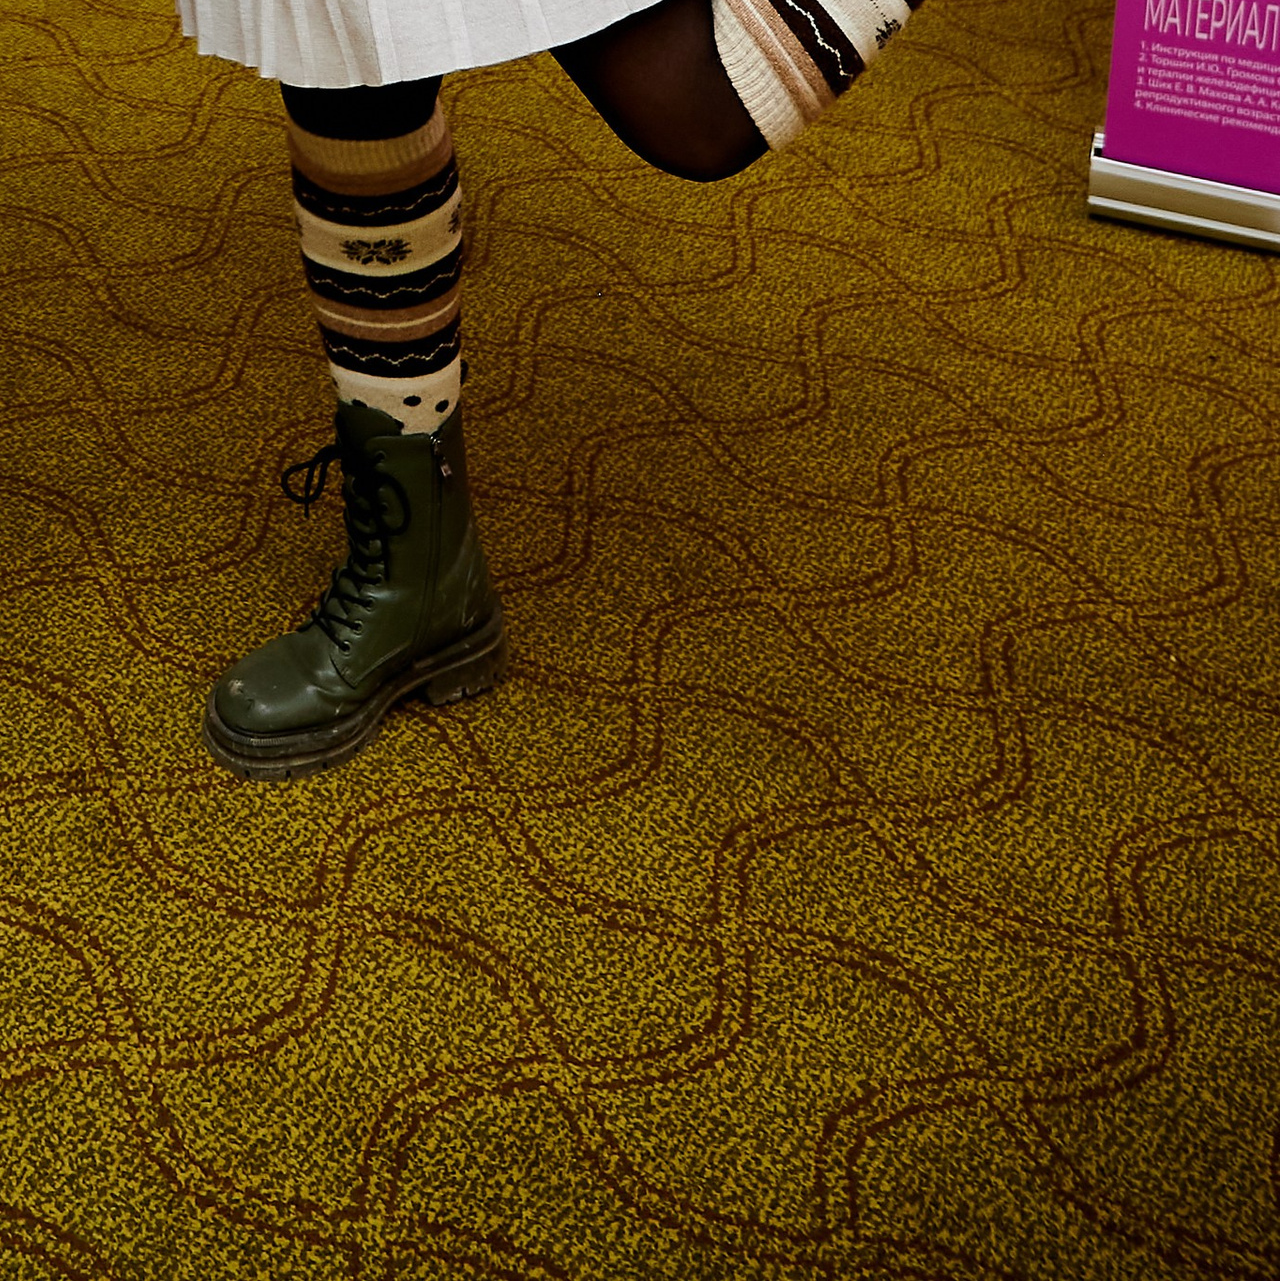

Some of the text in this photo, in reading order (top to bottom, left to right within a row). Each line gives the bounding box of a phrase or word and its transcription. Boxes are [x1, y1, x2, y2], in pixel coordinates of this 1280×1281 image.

[1152, 43, 1219, 61] Инструкция
[1221, 55, 1235, 64] по
[1148, 67, 1193, 82] терапии
[1152, 54, 1193, 69] Торшин
[1227, 67, 1274, 84] Громова
[1135, 89, 1234, 113] репродуктивного
[1146, 101, 1220, 123] Клинические
